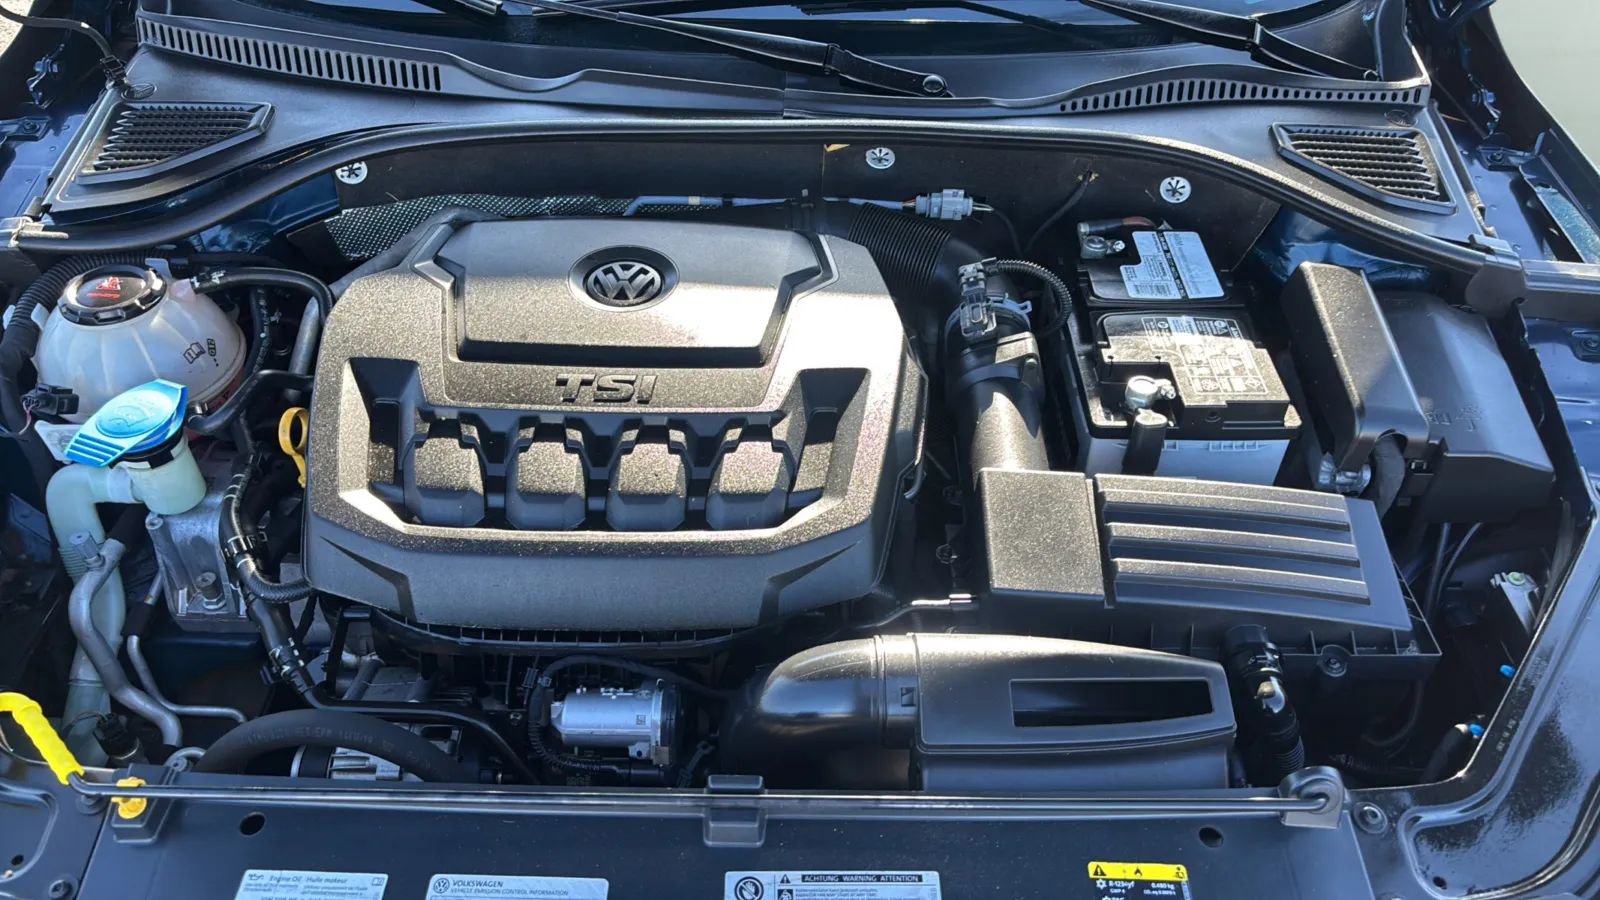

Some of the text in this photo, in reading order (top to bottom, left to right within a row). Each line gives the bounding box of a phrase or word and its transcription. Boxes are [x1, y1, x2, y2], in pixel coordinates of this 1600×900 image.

[556, 373, 659, 404] TSI
[270, 875, 291, 883] Engine
[804, 874, 919, 882] ACHTUNG WARNING ATTENTION
[453, 879, 504, 888] VOLKSWAGEN
